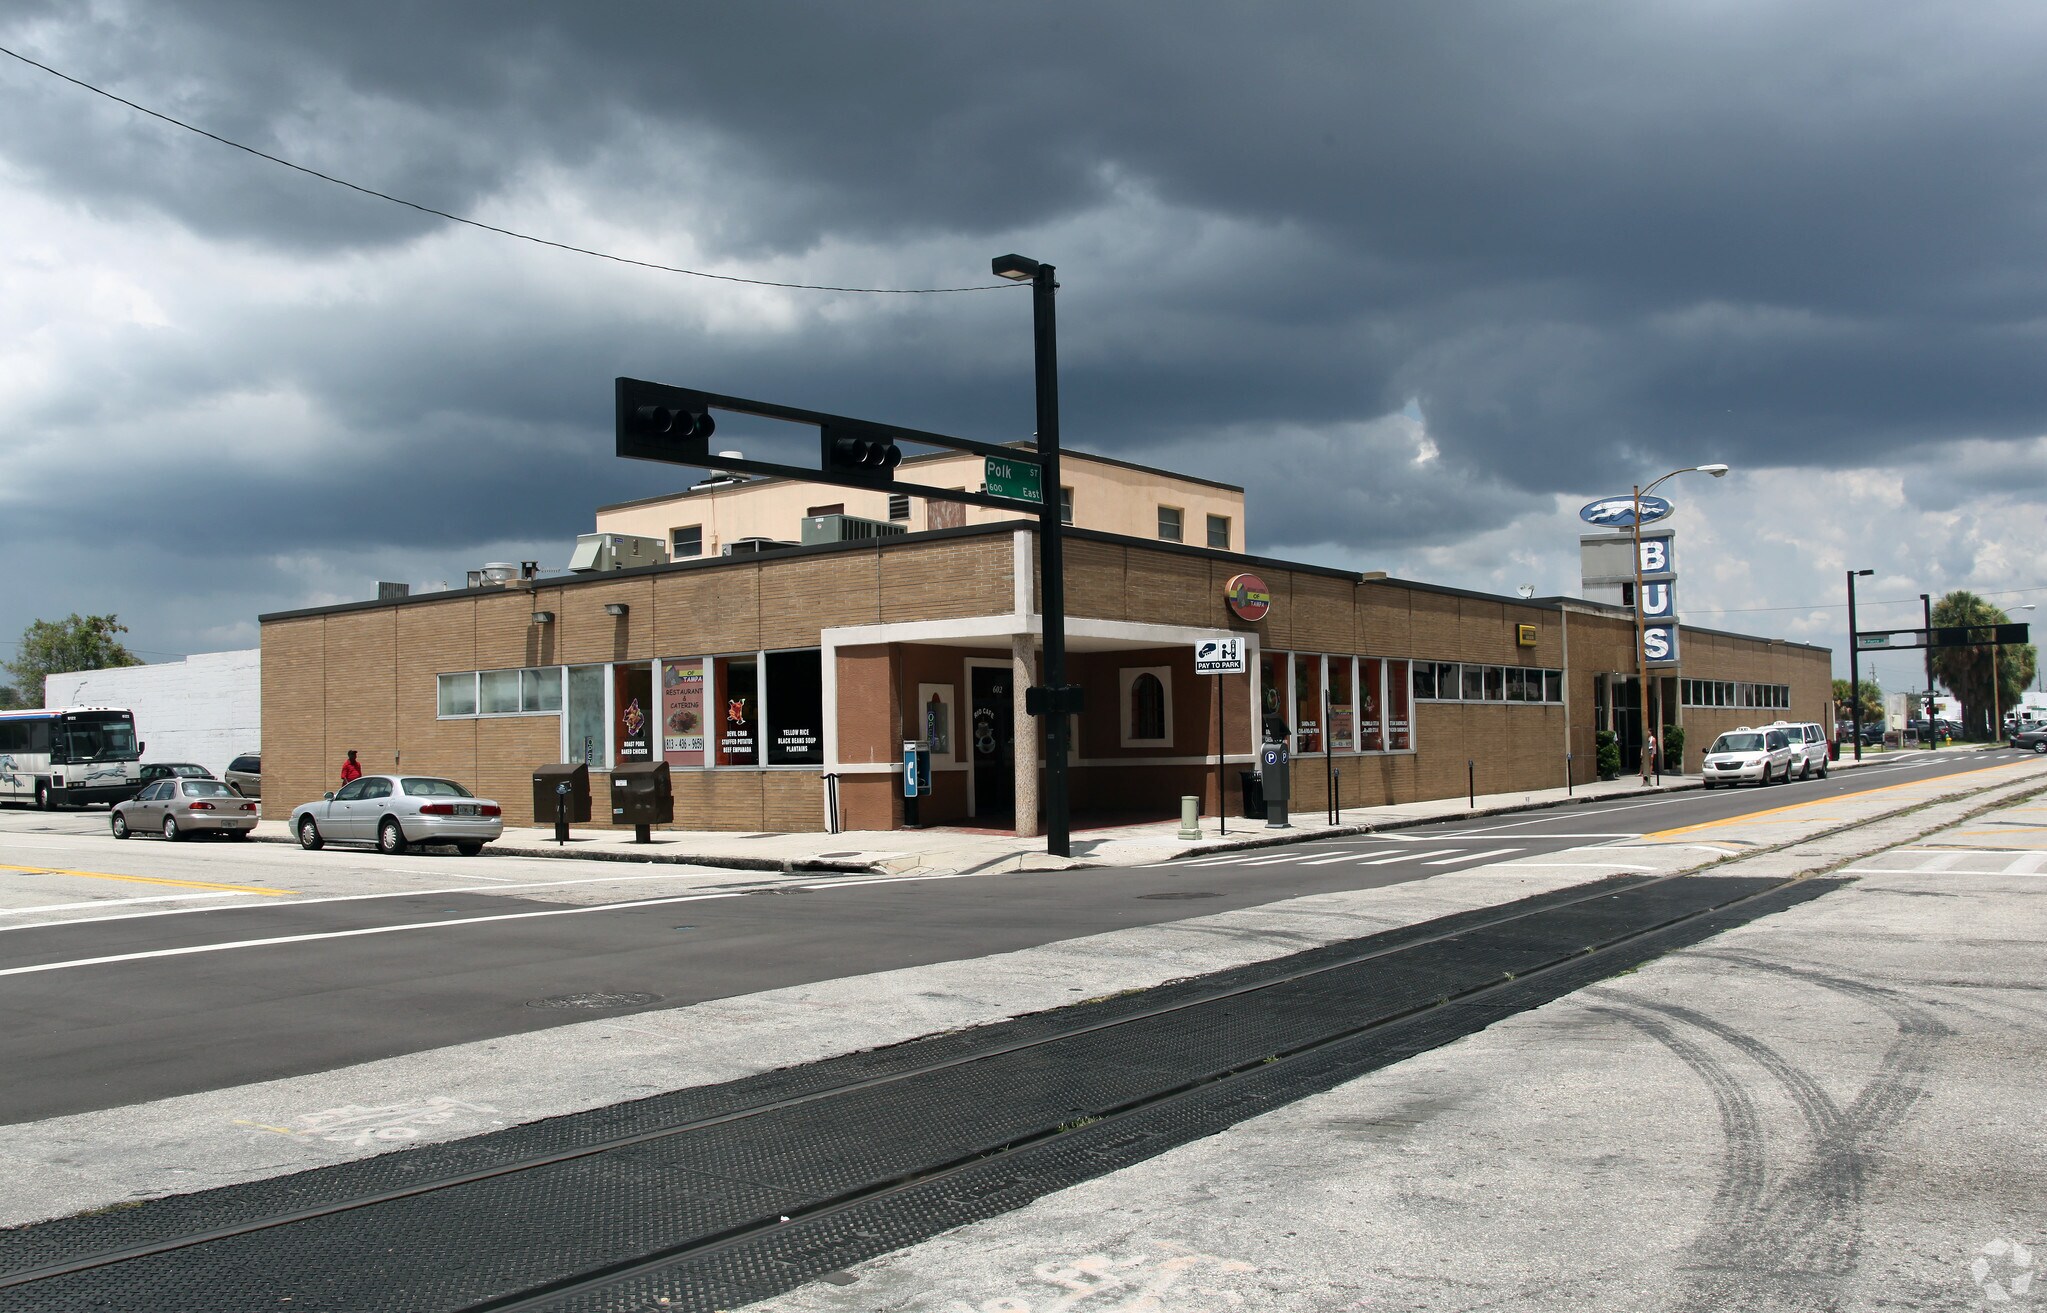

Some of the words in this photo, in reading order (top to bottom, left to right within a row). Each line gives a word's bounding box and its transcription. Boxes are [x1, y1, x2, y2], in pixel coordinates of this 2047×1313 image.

[987, 461, 1012, 479] Polk
[1030, 469, 1038, 477] ST
[989, 484, 1003, 492] 600
[1023, 487, 1040, 499] East
[1640, 541, 1669, 658] BUS
[666, 688, 703, 696] RESTAURANT
[992, 686, 1003, 694] 602
[666, 738, 674, 749] 813
[1268, 754, 1274, 762] P
